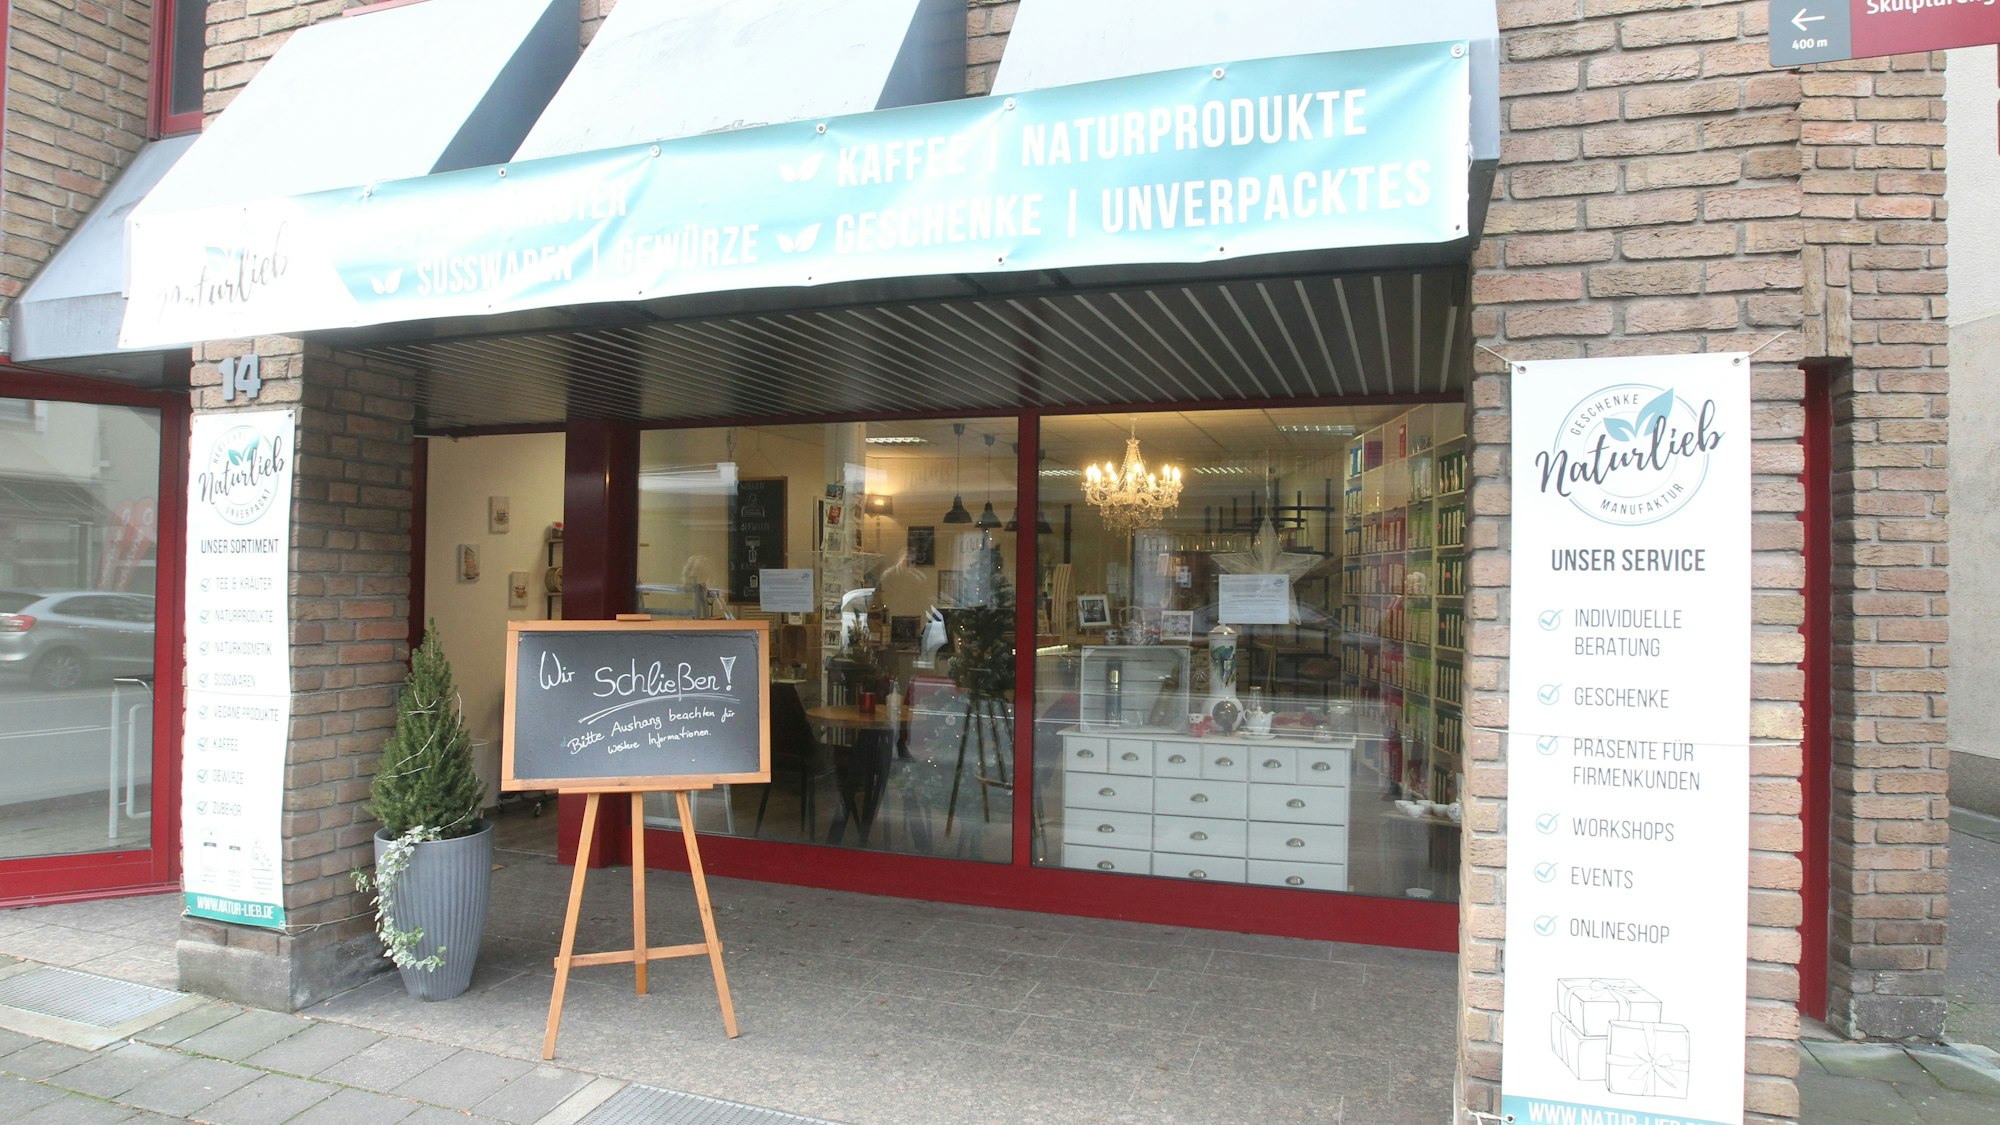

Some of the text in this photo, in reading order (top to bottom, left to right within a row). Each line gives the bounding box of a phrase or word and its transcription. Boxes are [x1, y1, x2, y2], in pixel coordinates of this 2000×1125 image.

[1792, 38, 1828, 50] 400 m
[837, 88, 1367, 187] KAFFEE NATURPRODUKTE
[834, 194, 1043, 254] GESCHENKE
[1101, 160, 1431, 234] UNVERPACKTES
[218, 353, 262, 401] 14
[1570, 393, 1640, 436] GESCHENKE
[1535, 399, 1726, 498] Naturlieb
[198, 435, 285, 505] Naturlieb
[1600, 482, 1685, 516] MANUFAKTUR
[201, 538, 279, 554] UNSER SORTIMENT
[1551, 548, 1706, 572] UNSER SERVICE
[1574, 608, 1682, 629] INDIVIDUELLE
[1574, 637, 1661, 657] BERATUNG
[539, 650, 576, 690] Wir
[1574, 687, 1670, 709] GESCHENKE
[567, 706, 736, 754] Bitte Aushang beachten für
[607, 740, 640, 755] weitere
[1573, 735, 1695, 762] PRÄSENTE FÜR
[1573, 766, 1701, 791] FIRMENKUNDEN
[1572, 817, 1675, 842] WORKSHOPS
[1571, 866, 1634, 889] EVENTS
[1569, 917, 1671, 944] ONLINESHOP
